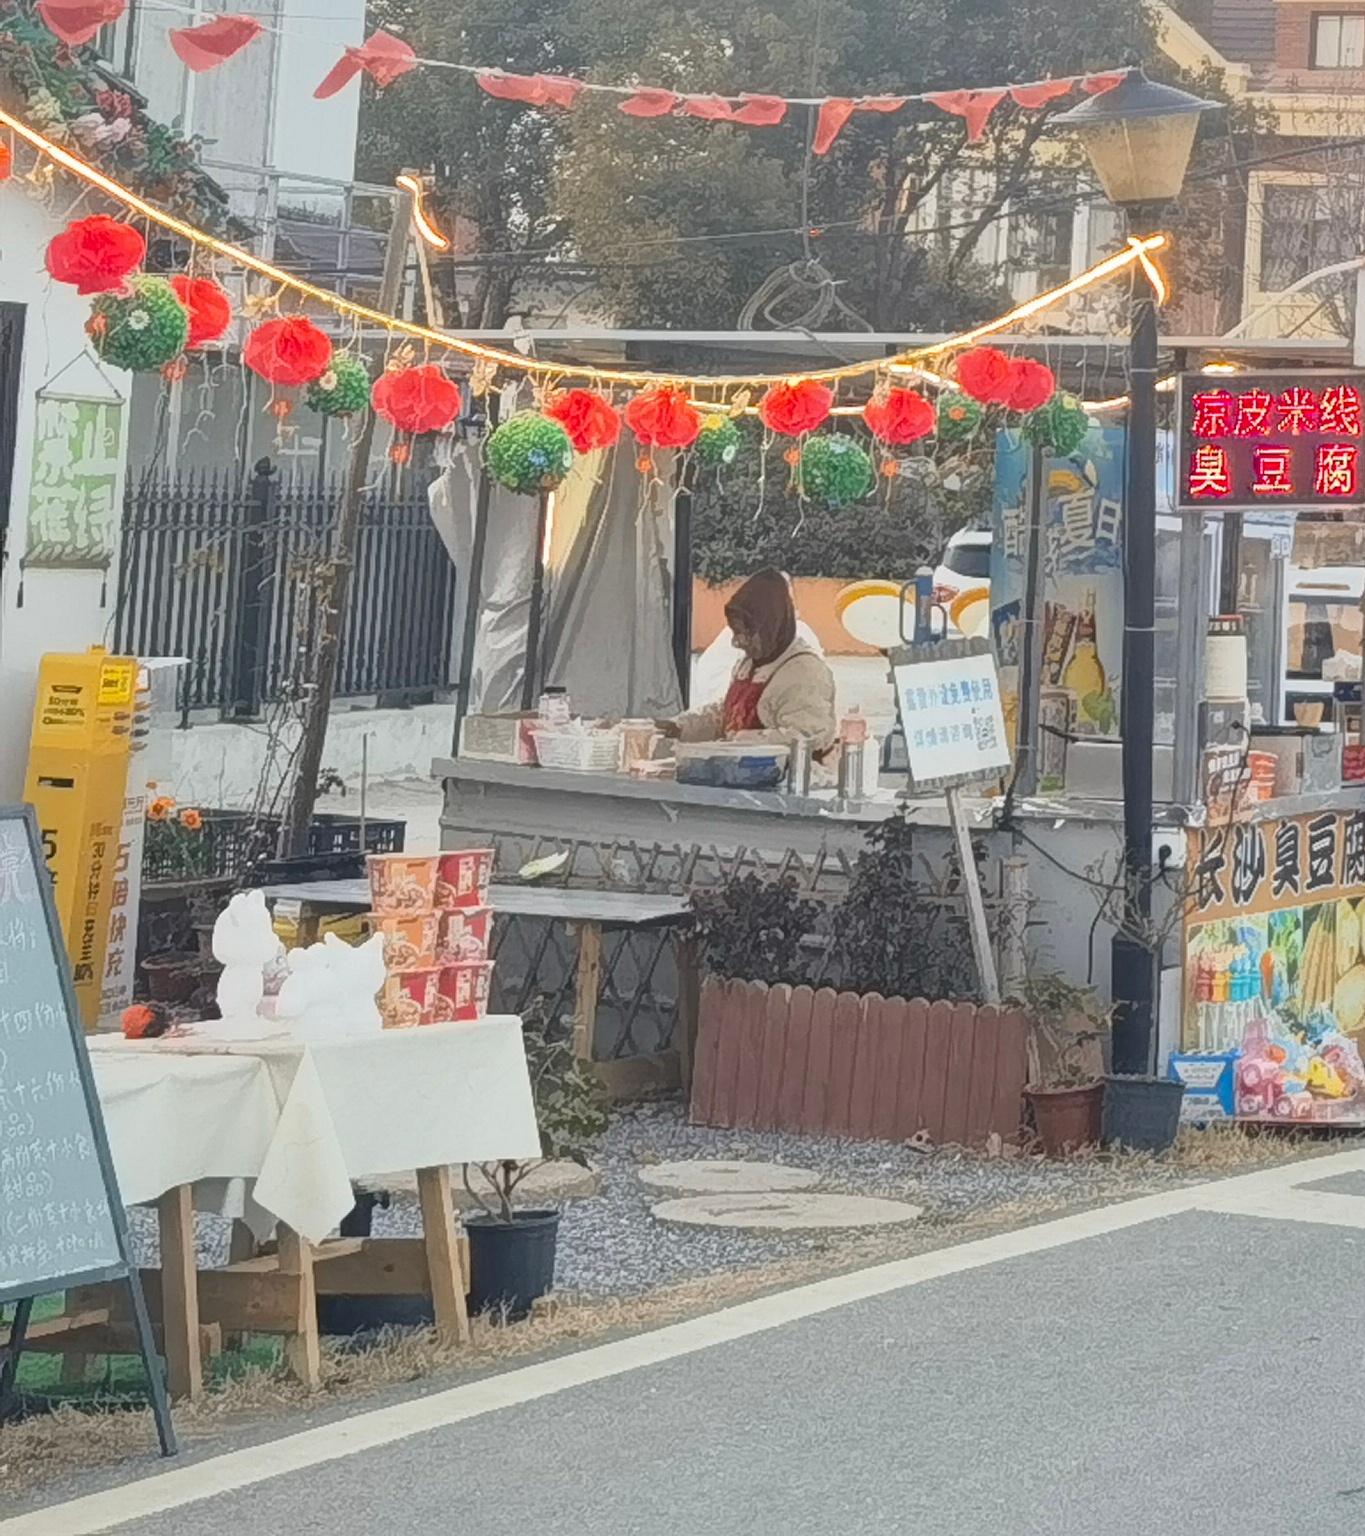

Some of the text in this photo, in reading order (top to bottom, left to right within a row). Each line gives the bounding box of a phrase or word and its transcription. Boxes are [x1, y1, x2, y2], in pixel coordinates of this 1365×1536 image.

[1191, 384, 1362, 438] 凉皮米线
[1189, 444, 1360, 497] 臭豆腐
